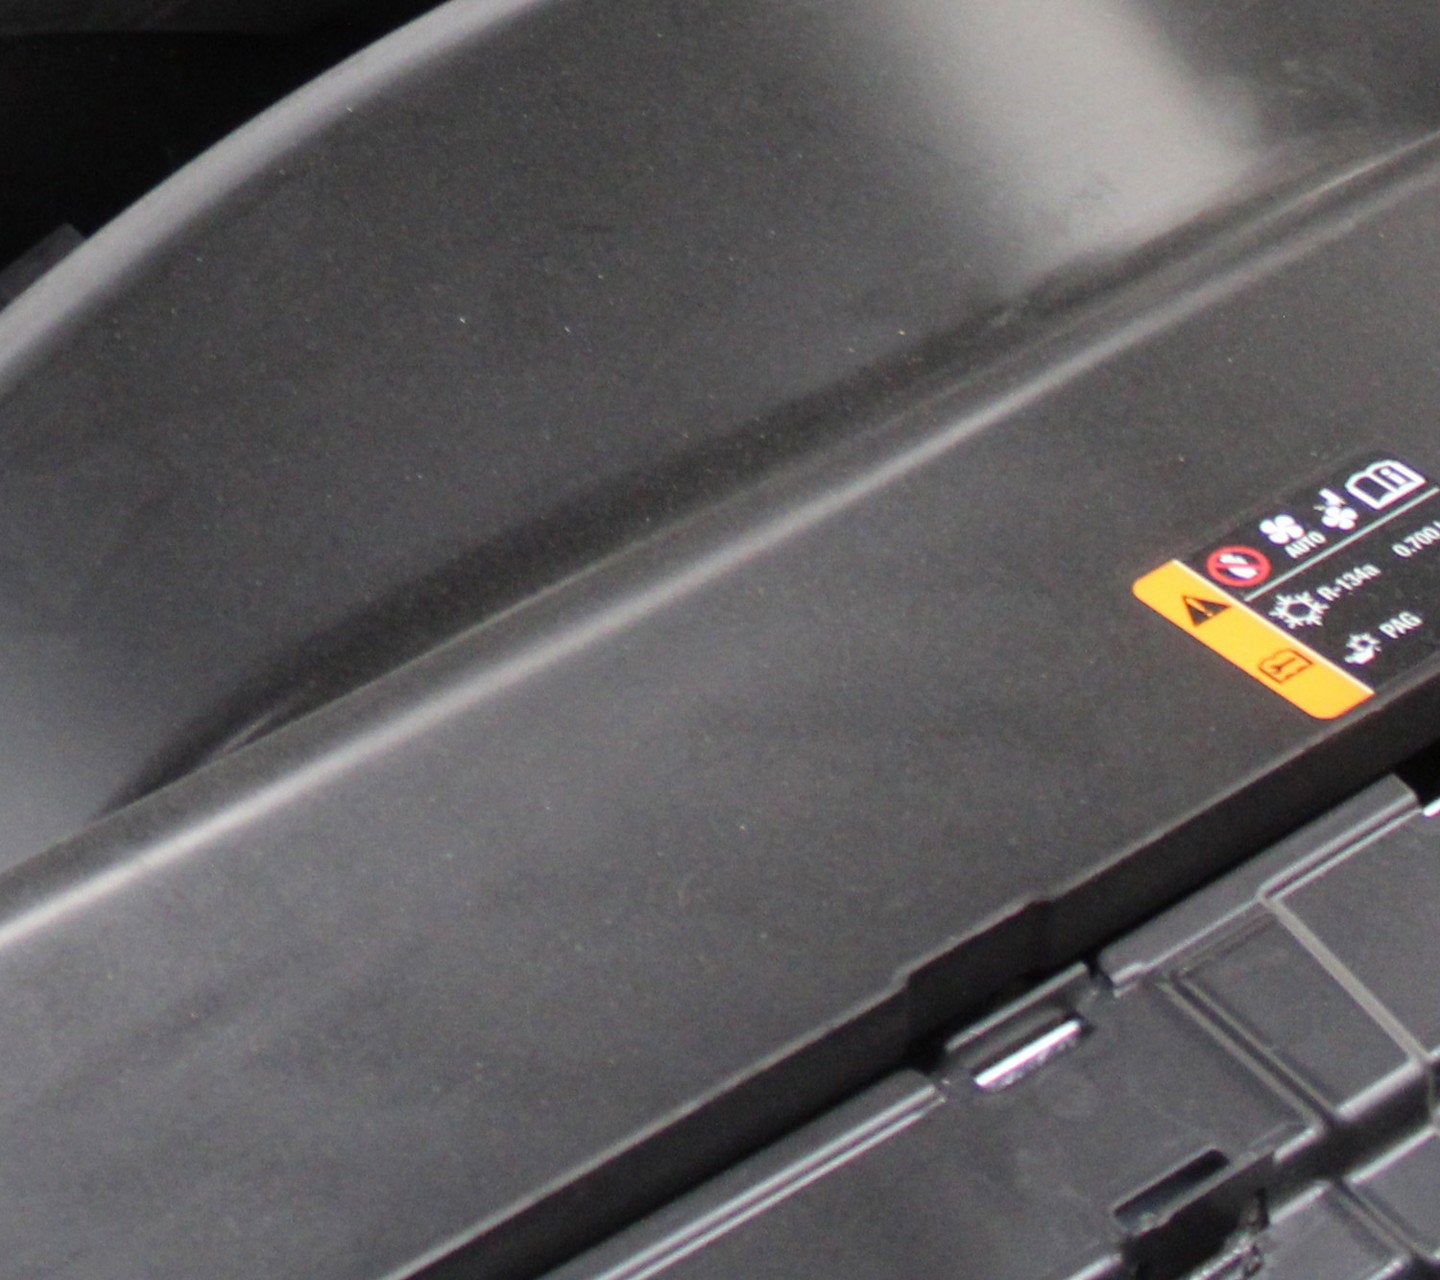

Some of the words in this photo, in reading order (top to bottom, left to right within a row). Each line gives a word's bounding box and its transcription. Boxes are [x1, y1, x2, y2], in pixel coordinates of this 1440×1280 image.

[1284, 531, 1326, 559] AUTO
[1316, 563, 1382, 601] R-134a
[1378, 610, 1422, 639] PAG
